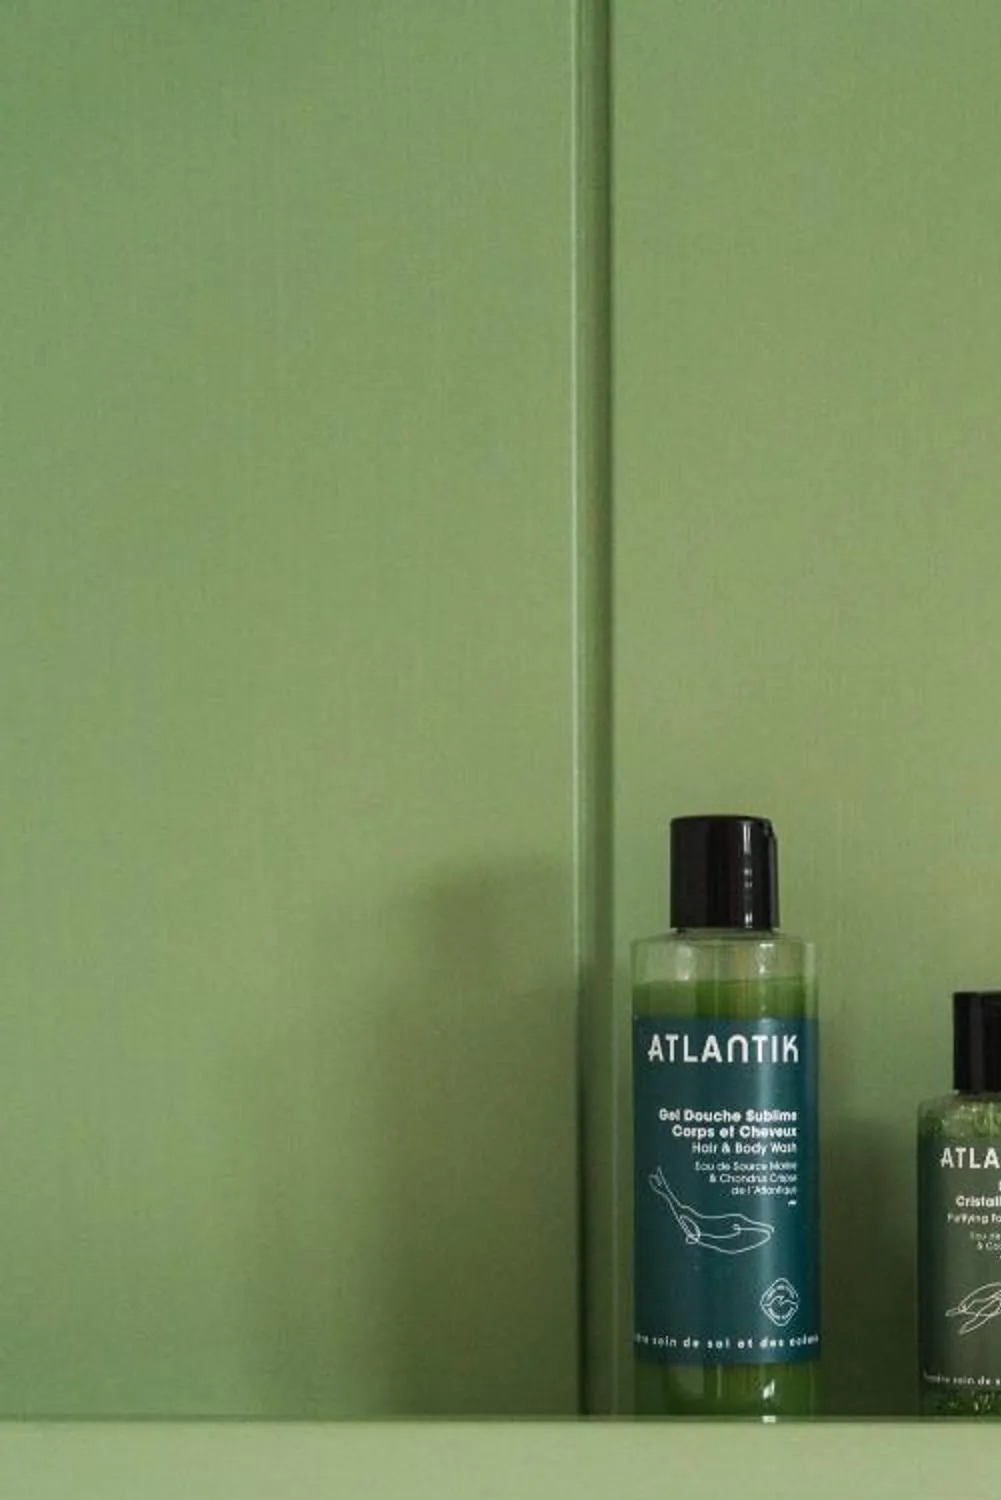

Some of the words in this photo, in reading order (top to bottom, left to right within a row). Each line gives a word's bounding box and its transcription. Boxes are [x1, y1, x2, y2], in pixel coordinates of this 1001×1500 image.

[648, 1033, 799, 1064] ATLANTIK
[659, 1108, 681, 1122] Gel
[683, 1108, 742, 1122] Douche
[745, 1108, 798, 1122] Sublime
[672, 1125, 715, 1140] Corps
[719, 1125, 735, 1138] et
[739, 1124, 798, 1138] Cheveux
[692, 1142, 717, 1153] Hair
[721, 1142, 731, 1153] &
[735, 1142, 767, 1156] Body
[770, 1142, 798, 1153] Wash
[683, 1336, 700, 1349] de
